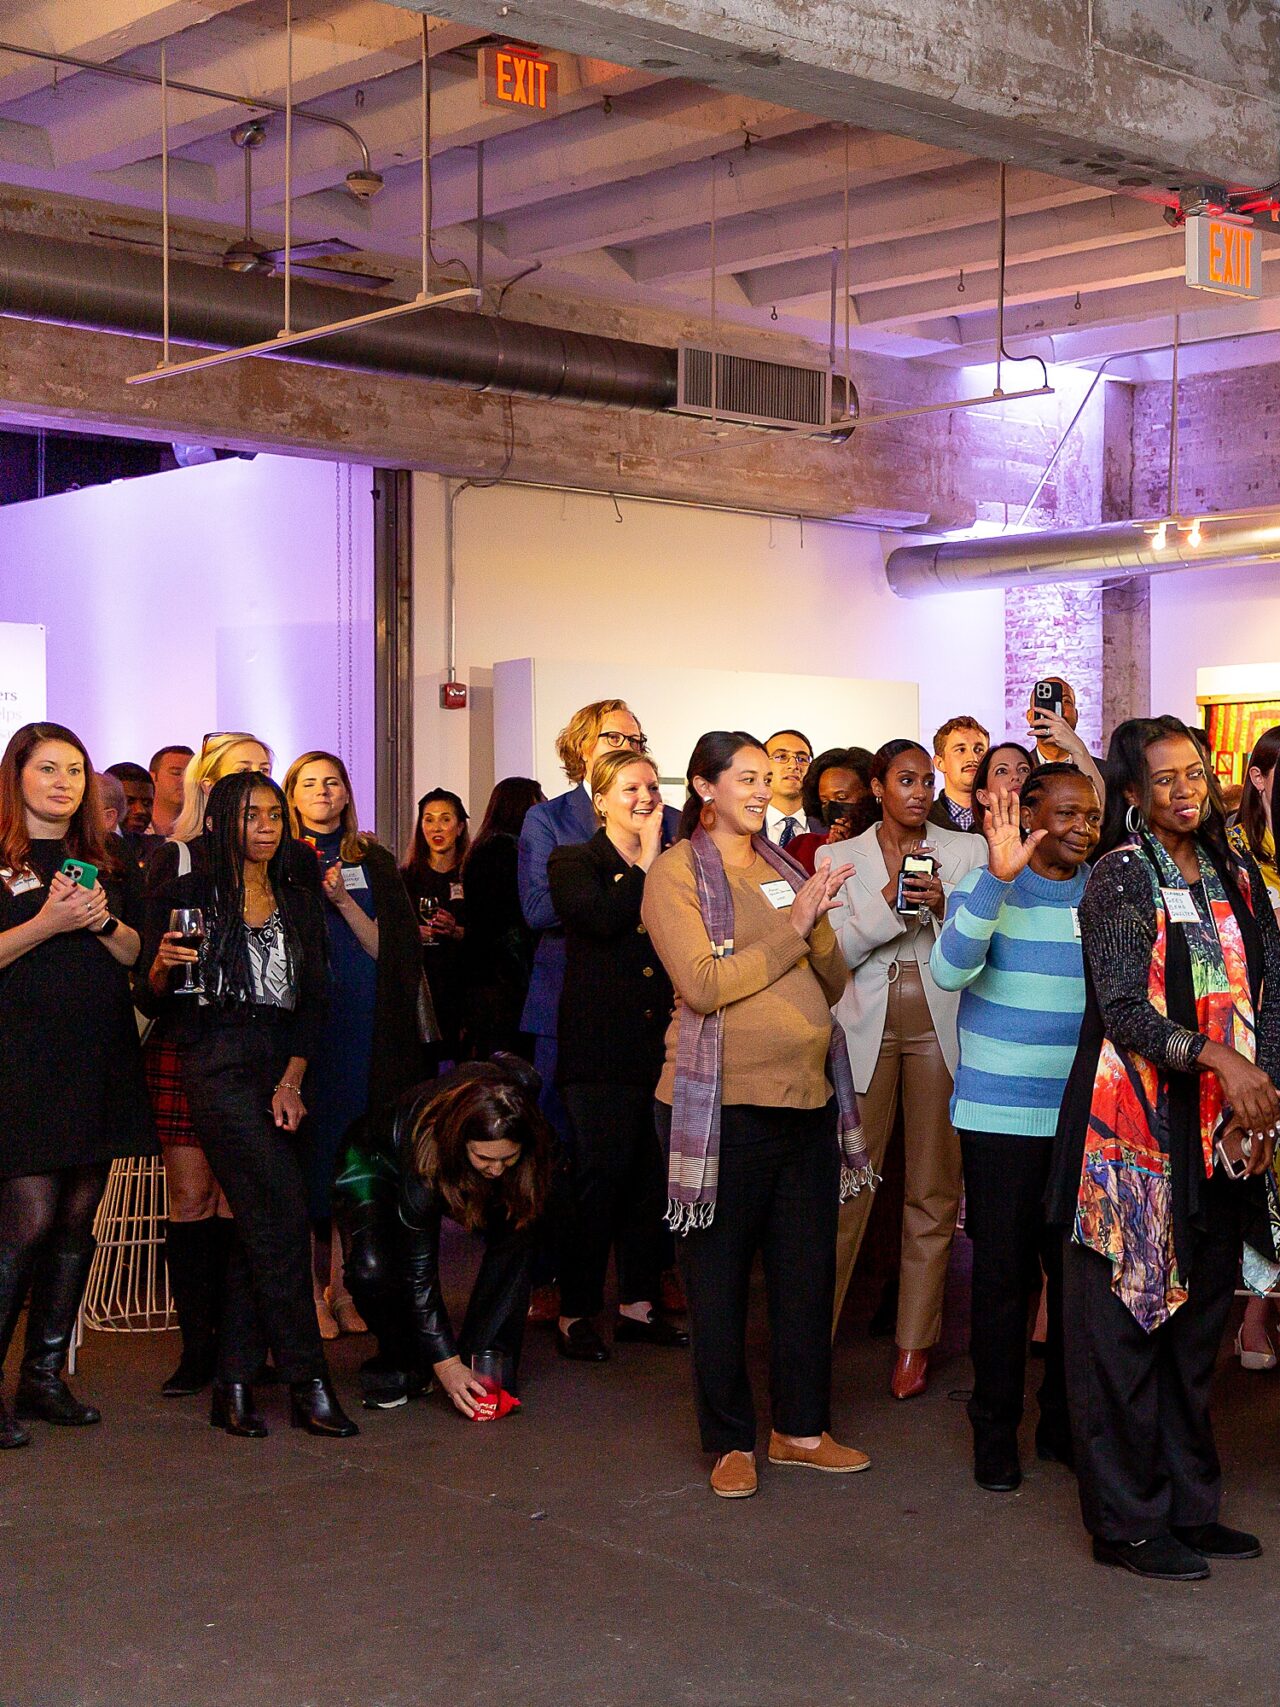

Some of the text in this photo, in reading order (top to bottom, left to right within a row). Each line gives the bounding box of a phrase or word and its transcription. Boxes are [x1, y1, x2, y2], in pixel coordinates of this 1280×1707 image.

[496, 52, 550, 110] EXIT
[1209, 222, 1254, 289] EXIT
[0, 707, 22, 723] lps
